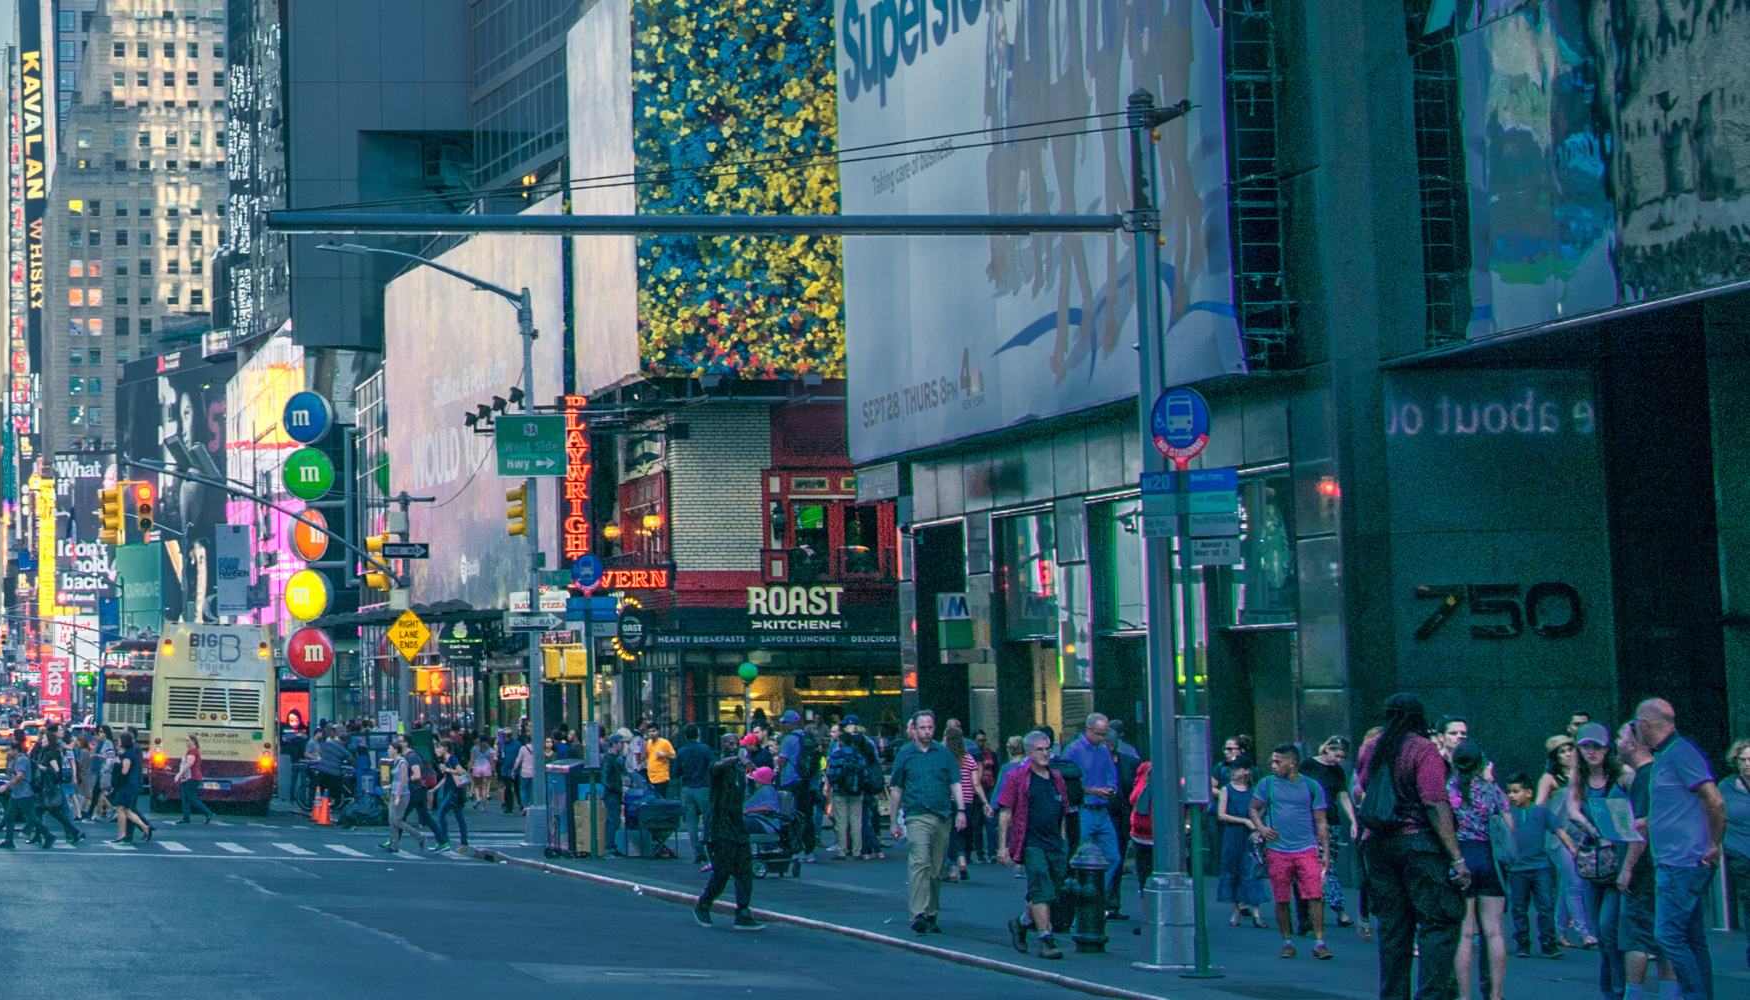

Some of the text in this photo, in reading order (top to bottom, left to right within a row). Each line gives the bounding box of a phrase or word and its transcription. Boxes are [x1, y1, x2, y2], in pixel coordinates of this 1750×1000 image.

[22, 50, 44, 200] KAVALAN
[872, 166, 895, 196] Taking
[895, 159, 911, 184] care
[912, 152, 920, 174] of
[29, 216, 43, 309] WHISKY
[959, 347, 972, 396] 4
[862, 395, 886, 428] SEPT
[886, 390, 900, 422] 28
[903, 378, 939, 416] THURS
[292, 408, 310, 426] m
[524, 424, 538, 435] 9A
[504, 440, 560, 452] West Side
[1158, 438, 1204, 458] NO STANDING
[411, 426, 460, 492] WOULD
[506, 458, 531, 471] Hwy
[57, 460, 102, 478] What
[300, 464, 321, 483] m
[57, 478, 70, 496] if
[310, 522, 326, 544] m
[57, 538, 108, 557] I don't
[1194, 549, 1211, 558] West
[218, 556, 240, 564] DEAR
[218, 562, 240, 570] EVAN
[62, 572, 109, 590] back.
[218, 568, 250, 578] HANSEN
[600, 569, 668, 589] VERN
[292, 586, 310, 604] m
[746, 586, 844, 616] ROAST
[540, 602, 567, 610] PIZZA
[1412, 580, 1584, 640] 750
[58, 620, 92, 632] Wat
[398, 619, 420, 630] RIGHT
[512, 616, 558, 626] ONE WAY
[762, 619, 832, 630] KITCHEN
[189, 632, 218, 648] BIG
[398, 630, 420, 640] LANE
[657, 634, 898, 644] HEARTY BREAKFASTS SAVORY LUNCHES DELICIOUS
[304, 644, 325, 662] m
[399, 640, 420, 650] ENDS
[188, 648, 218, 663] BUS
[200, 663, 232, 672] TOURS
[47, 660, 66, 696] tkts
[502, 686, 528, 696] ATM
